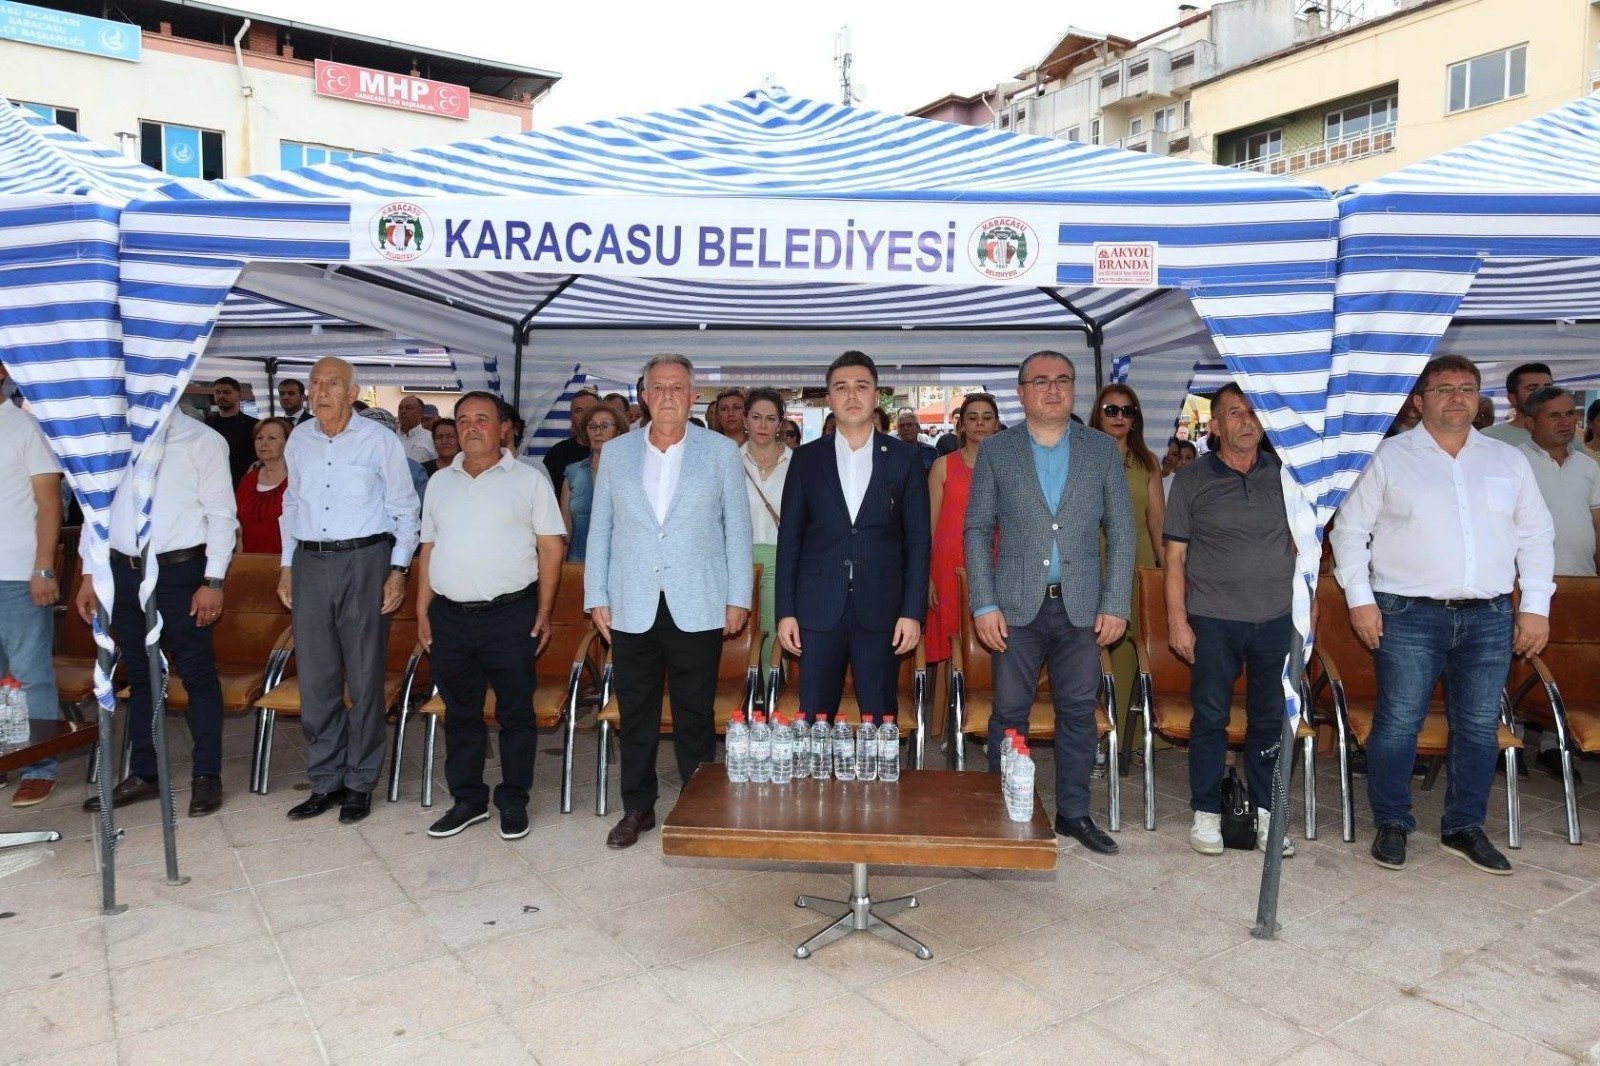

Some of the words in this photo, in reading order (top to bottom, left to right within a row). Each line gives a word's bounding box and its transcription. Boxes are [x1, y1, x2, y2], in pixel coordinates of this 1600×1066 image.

[359, 70, 430, 102] MHP
[382, 204, 423, 217] KARACASU
[982, 218, 1028, 232] KARACASU
[445, 218, 682, 267] KARACASU
[697, 218, 956, 274] BELEDİYESİ
[1110, 247, 1151, 258] AKYOL
[1098, 259, 1149, 270] BRANDA
